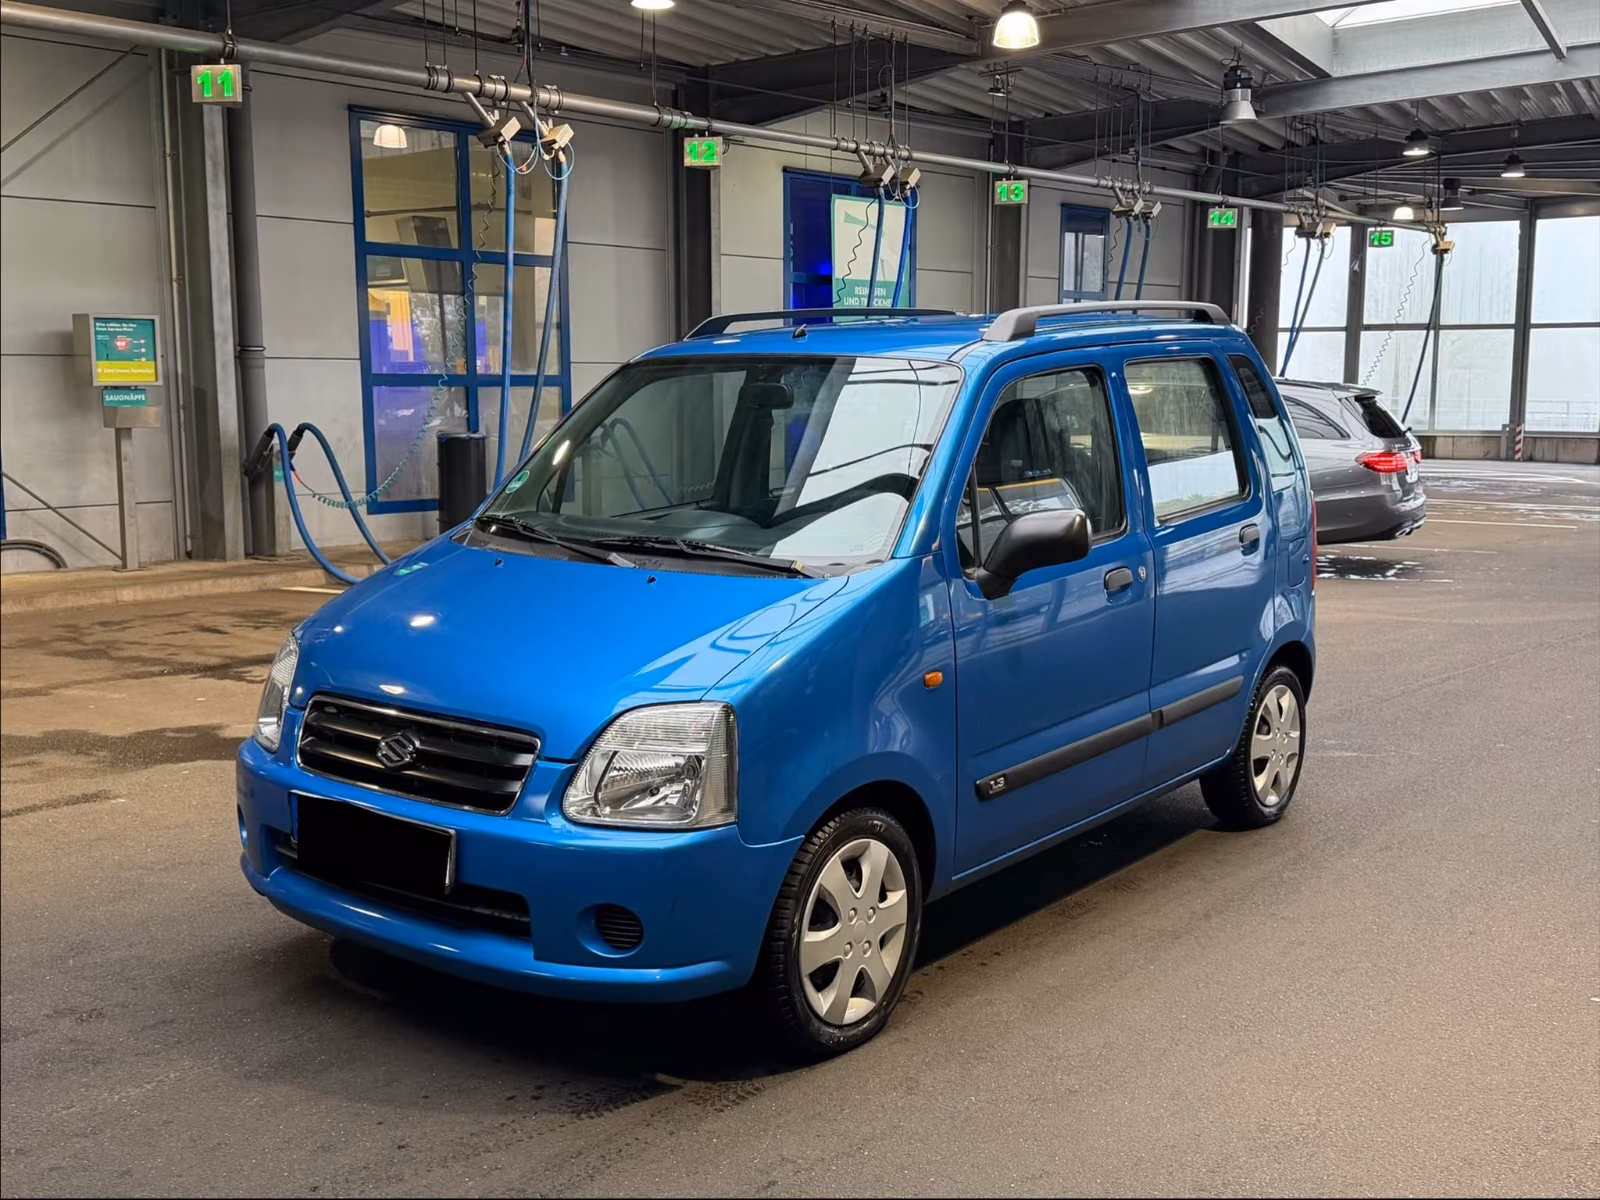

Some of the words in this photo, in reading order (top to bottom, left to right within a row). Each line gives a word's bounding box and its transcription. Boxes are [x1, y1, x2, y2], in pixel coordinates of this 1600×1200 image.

[197, 70, 233, 97] 11
[687, 141, 718, 163] 12
[997, 183, 1024, 201] 13
[1210, 211, 1234, 225] 14
[1371, 232, 1392, 245] 15
[844, 297, 859, 305] UND
[105, 393, 145, 401] SAUGNÄPFE
